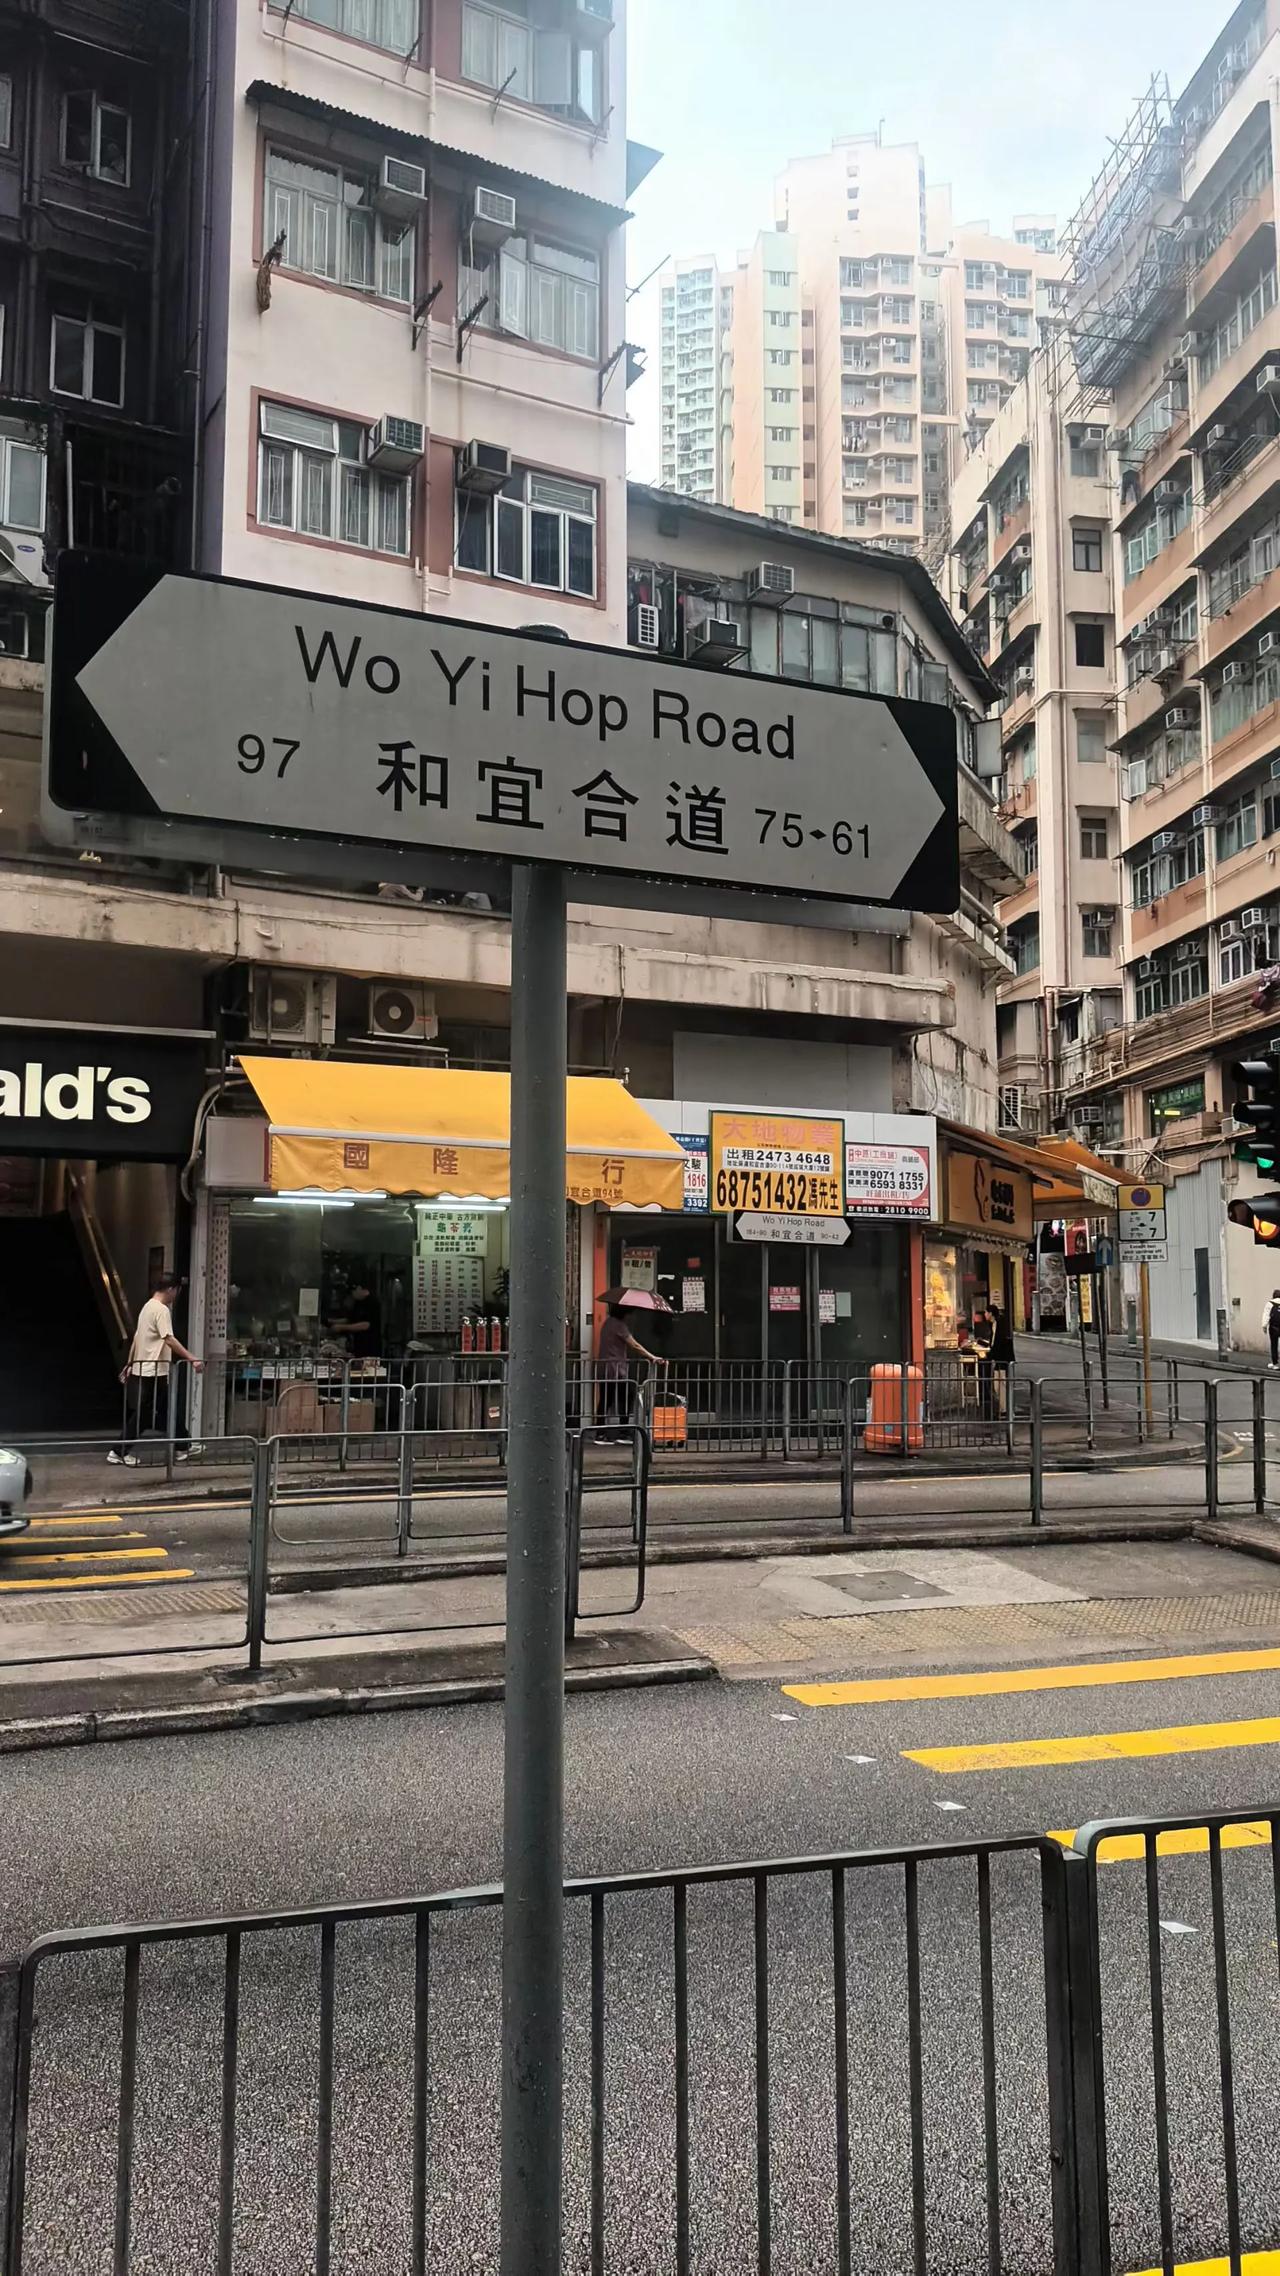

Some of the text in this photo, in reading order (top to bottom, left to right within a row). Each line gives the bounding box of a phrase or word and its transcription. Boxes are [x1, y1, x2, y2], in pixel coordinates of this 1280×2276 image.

[295, 625, 795, 760] Wo Yi Hop Road
[236, 733, 301, 779] 97
[375, 740, 730, 856] 和宜合道
[727, 1148, 831, 1165] 出租 2473 4648
[687, 1173, 706, 1188] 1816
[870, 1170, 895, 1180] 9071
[899, 1171, 924, 1181] 1755
[716, 1169, 808, 1211] 68751432
[870, 1180, 895, 1189] 6593
[899, 1181, 924, 1190] 8331
[804, 1218, 825, 1227] Road
[1148, 1211, 1156, 1222] 7
[1149, 1227, 1157, 1238] 7
